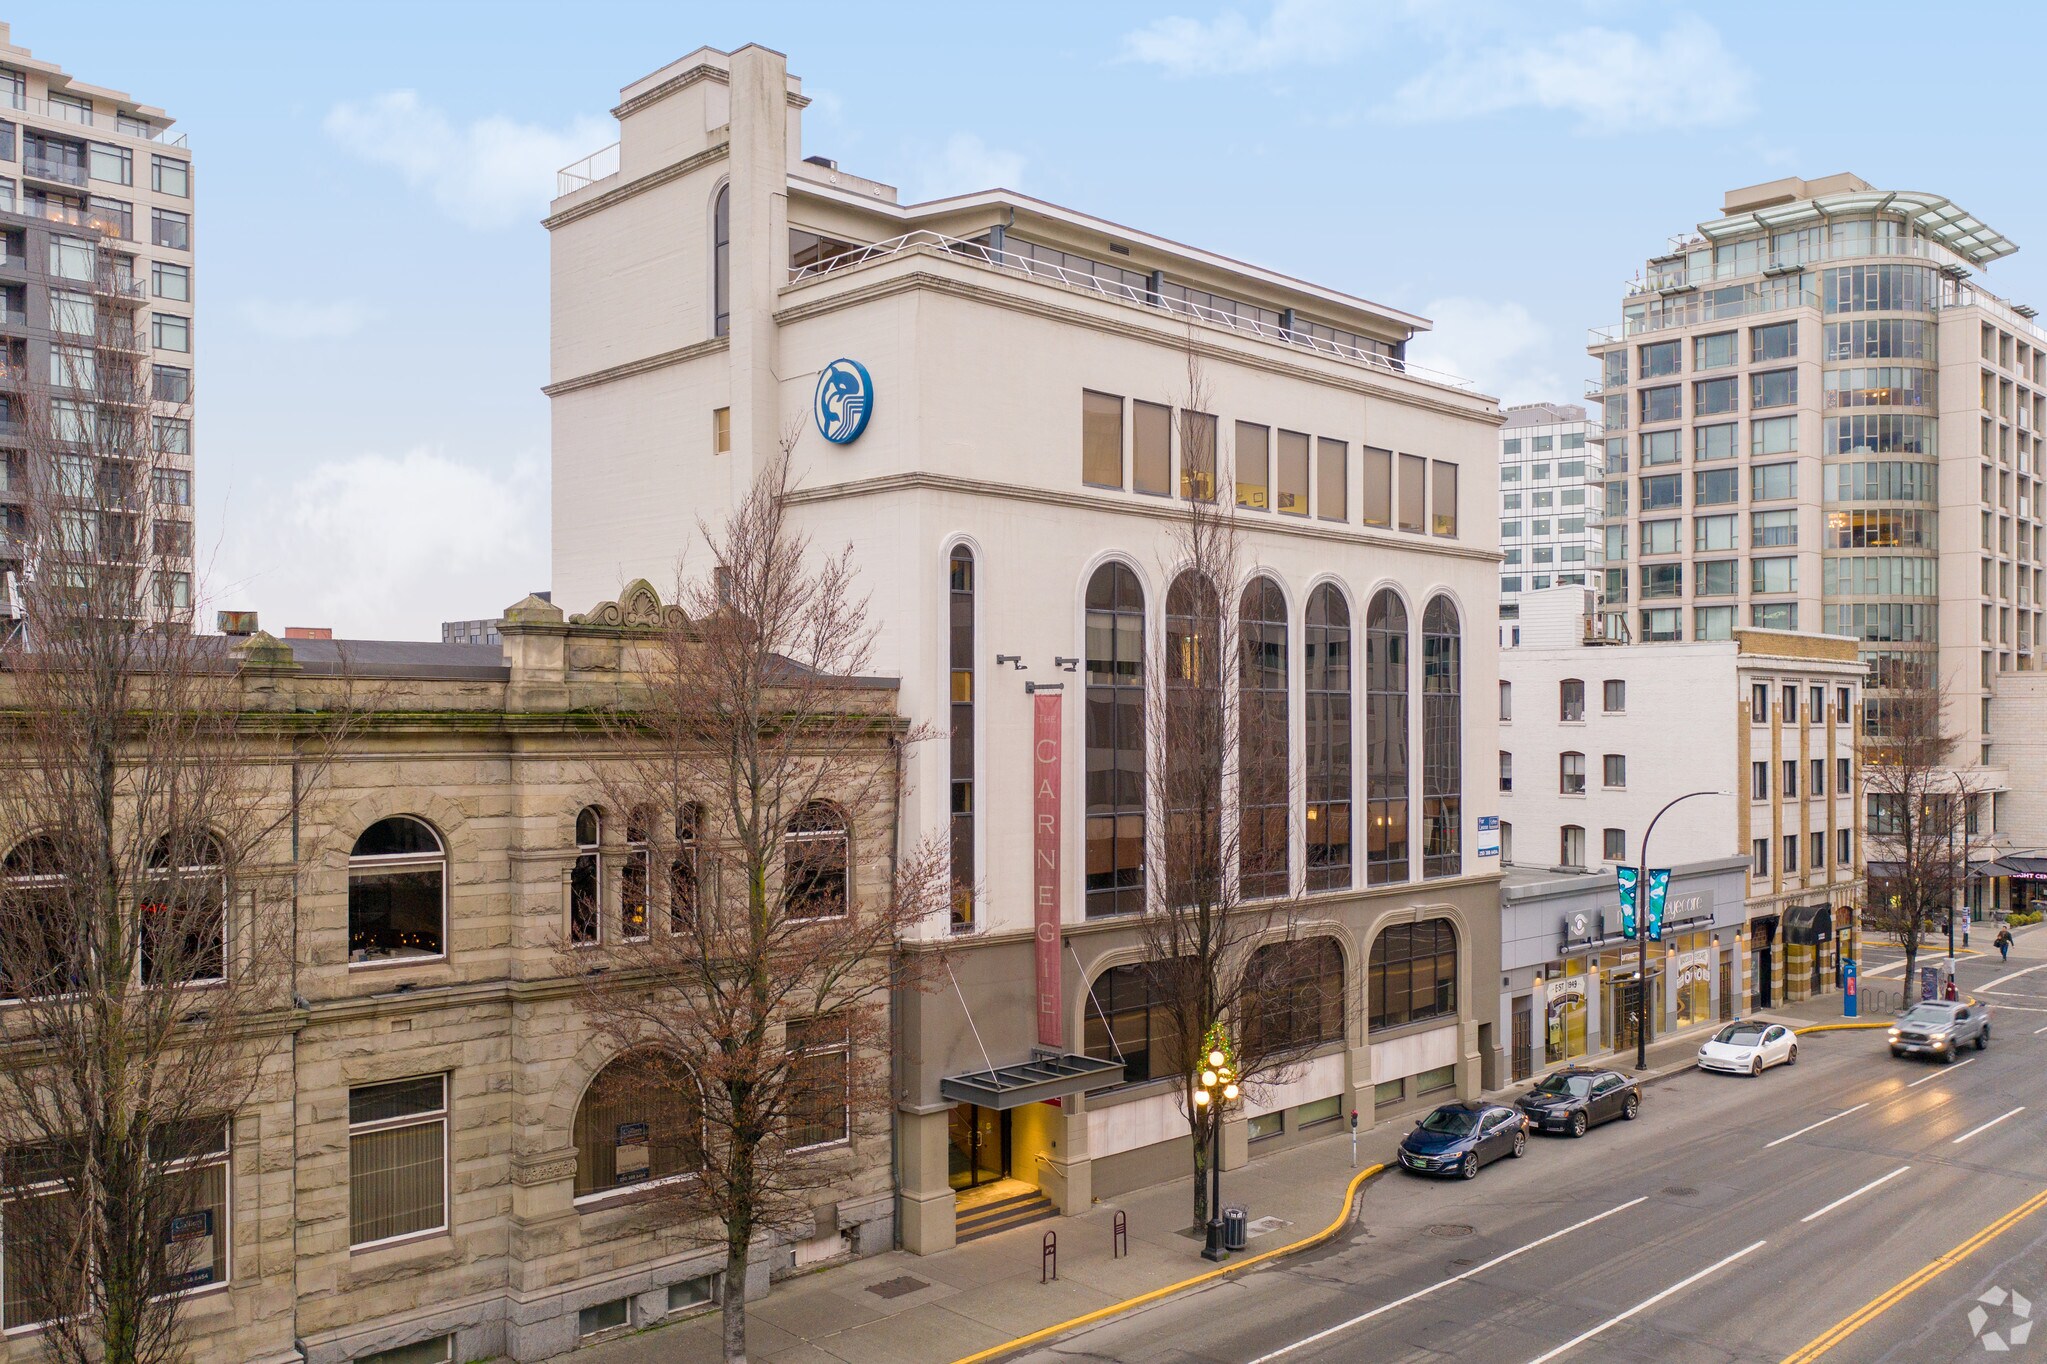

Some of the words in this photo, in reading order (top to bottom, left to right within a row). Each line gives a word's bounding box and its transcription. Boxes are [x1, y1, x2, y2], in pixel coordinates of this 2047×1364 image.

[1038, 714, 1057, 724] THE
[1036, 739, 1057, 1014] CARNEGIE
[1664, 896, 1703, 920] eyecare
